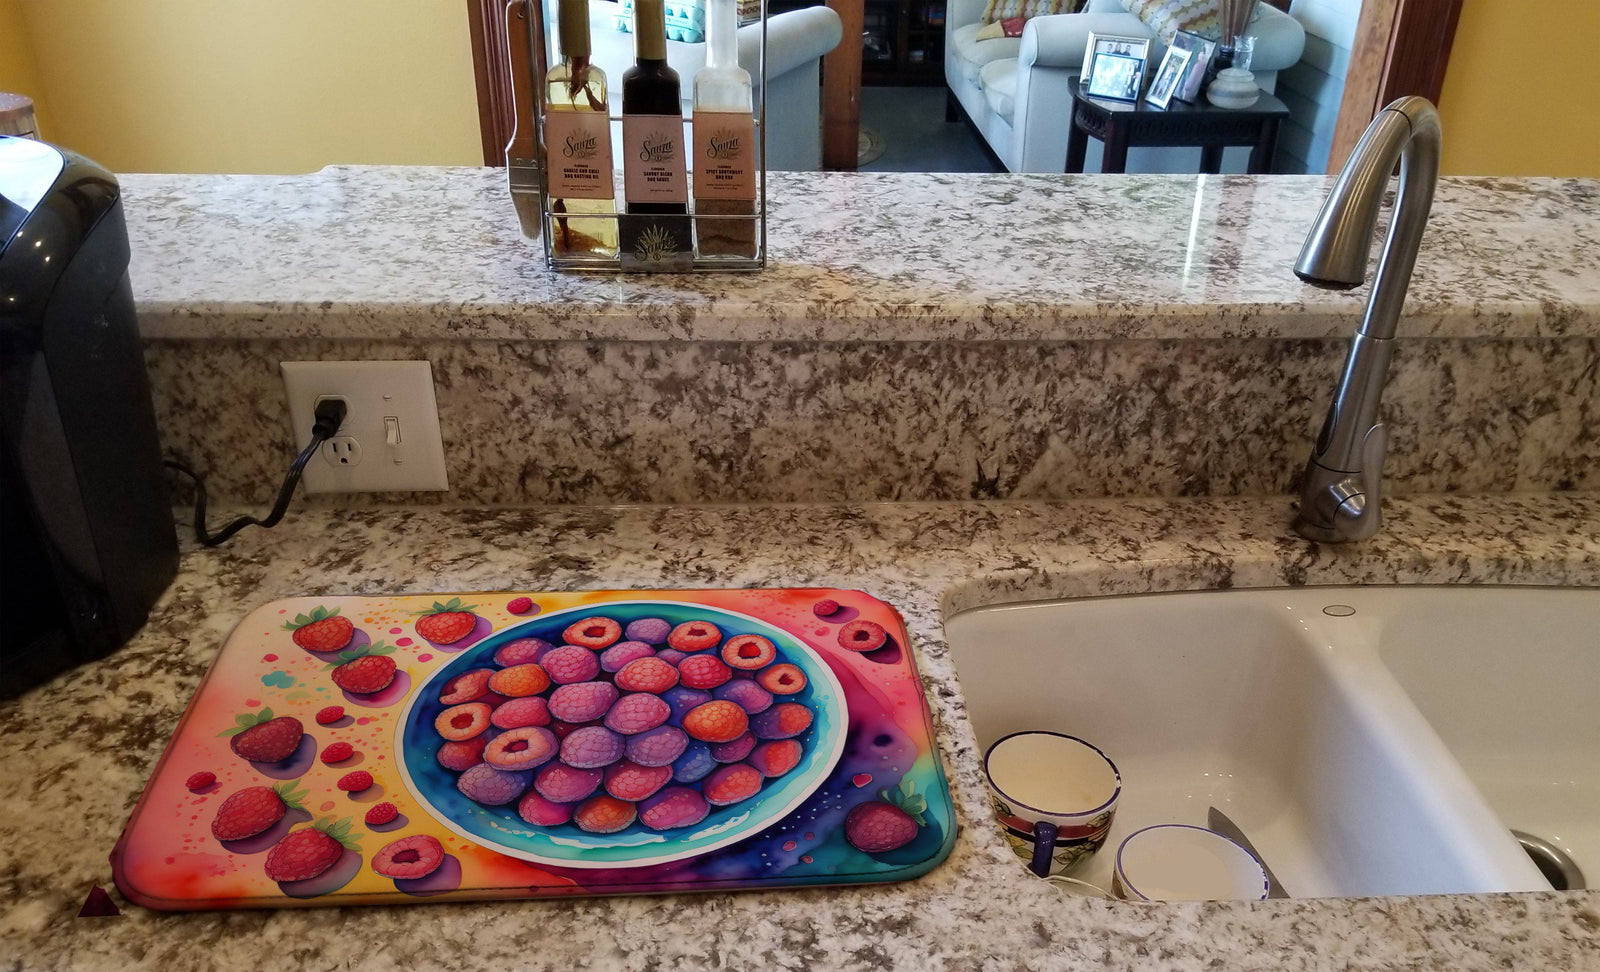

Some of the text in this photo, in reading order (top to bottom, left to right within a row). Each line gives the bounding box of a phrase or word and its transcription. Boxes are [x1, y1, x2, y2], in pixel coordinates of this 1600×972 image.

[562, 135, 597, 158] Sauza
[640, 140, 673, 161] Sauza
[706, 136, 740, 159] Sauza
